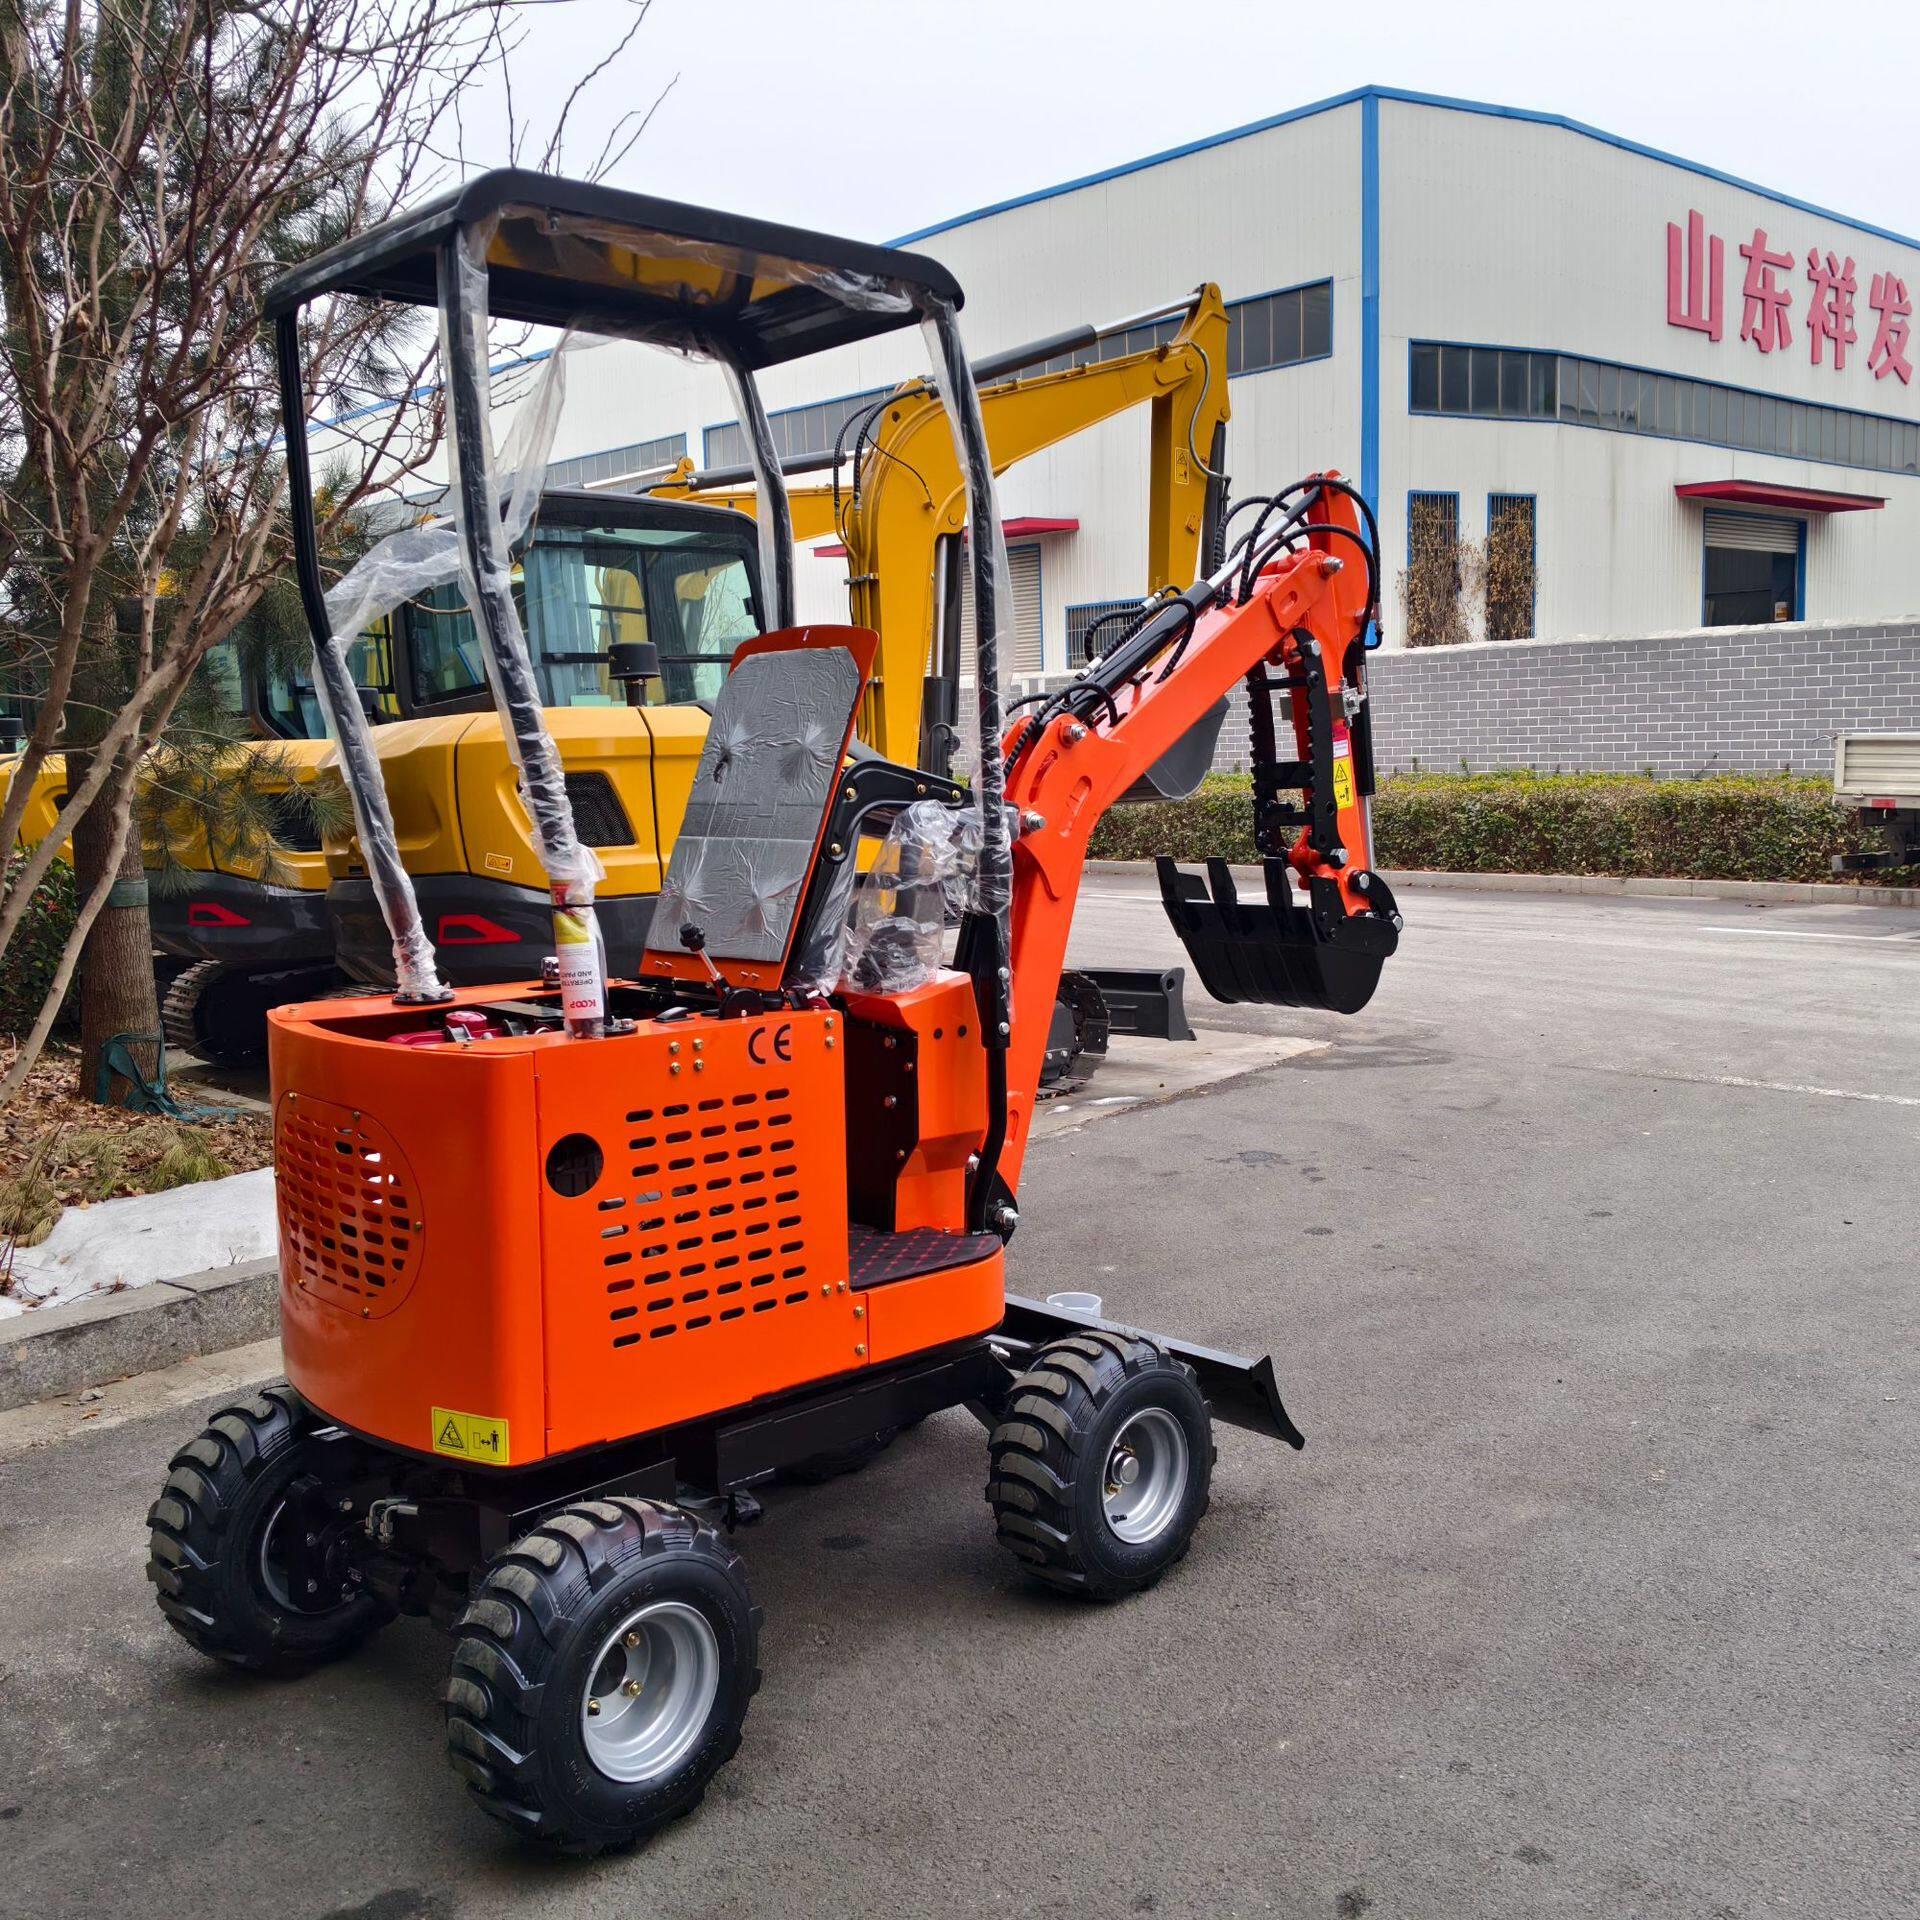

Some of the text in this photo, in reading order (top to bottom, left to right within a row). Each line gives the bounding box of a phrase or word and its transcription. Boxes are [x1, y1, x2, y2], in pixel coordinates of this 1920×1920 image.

[1667, 208, 1913, 385] 山东祥发
[577, 970, 592, 978] AND
[748, 1024, 792, 1065] CE
